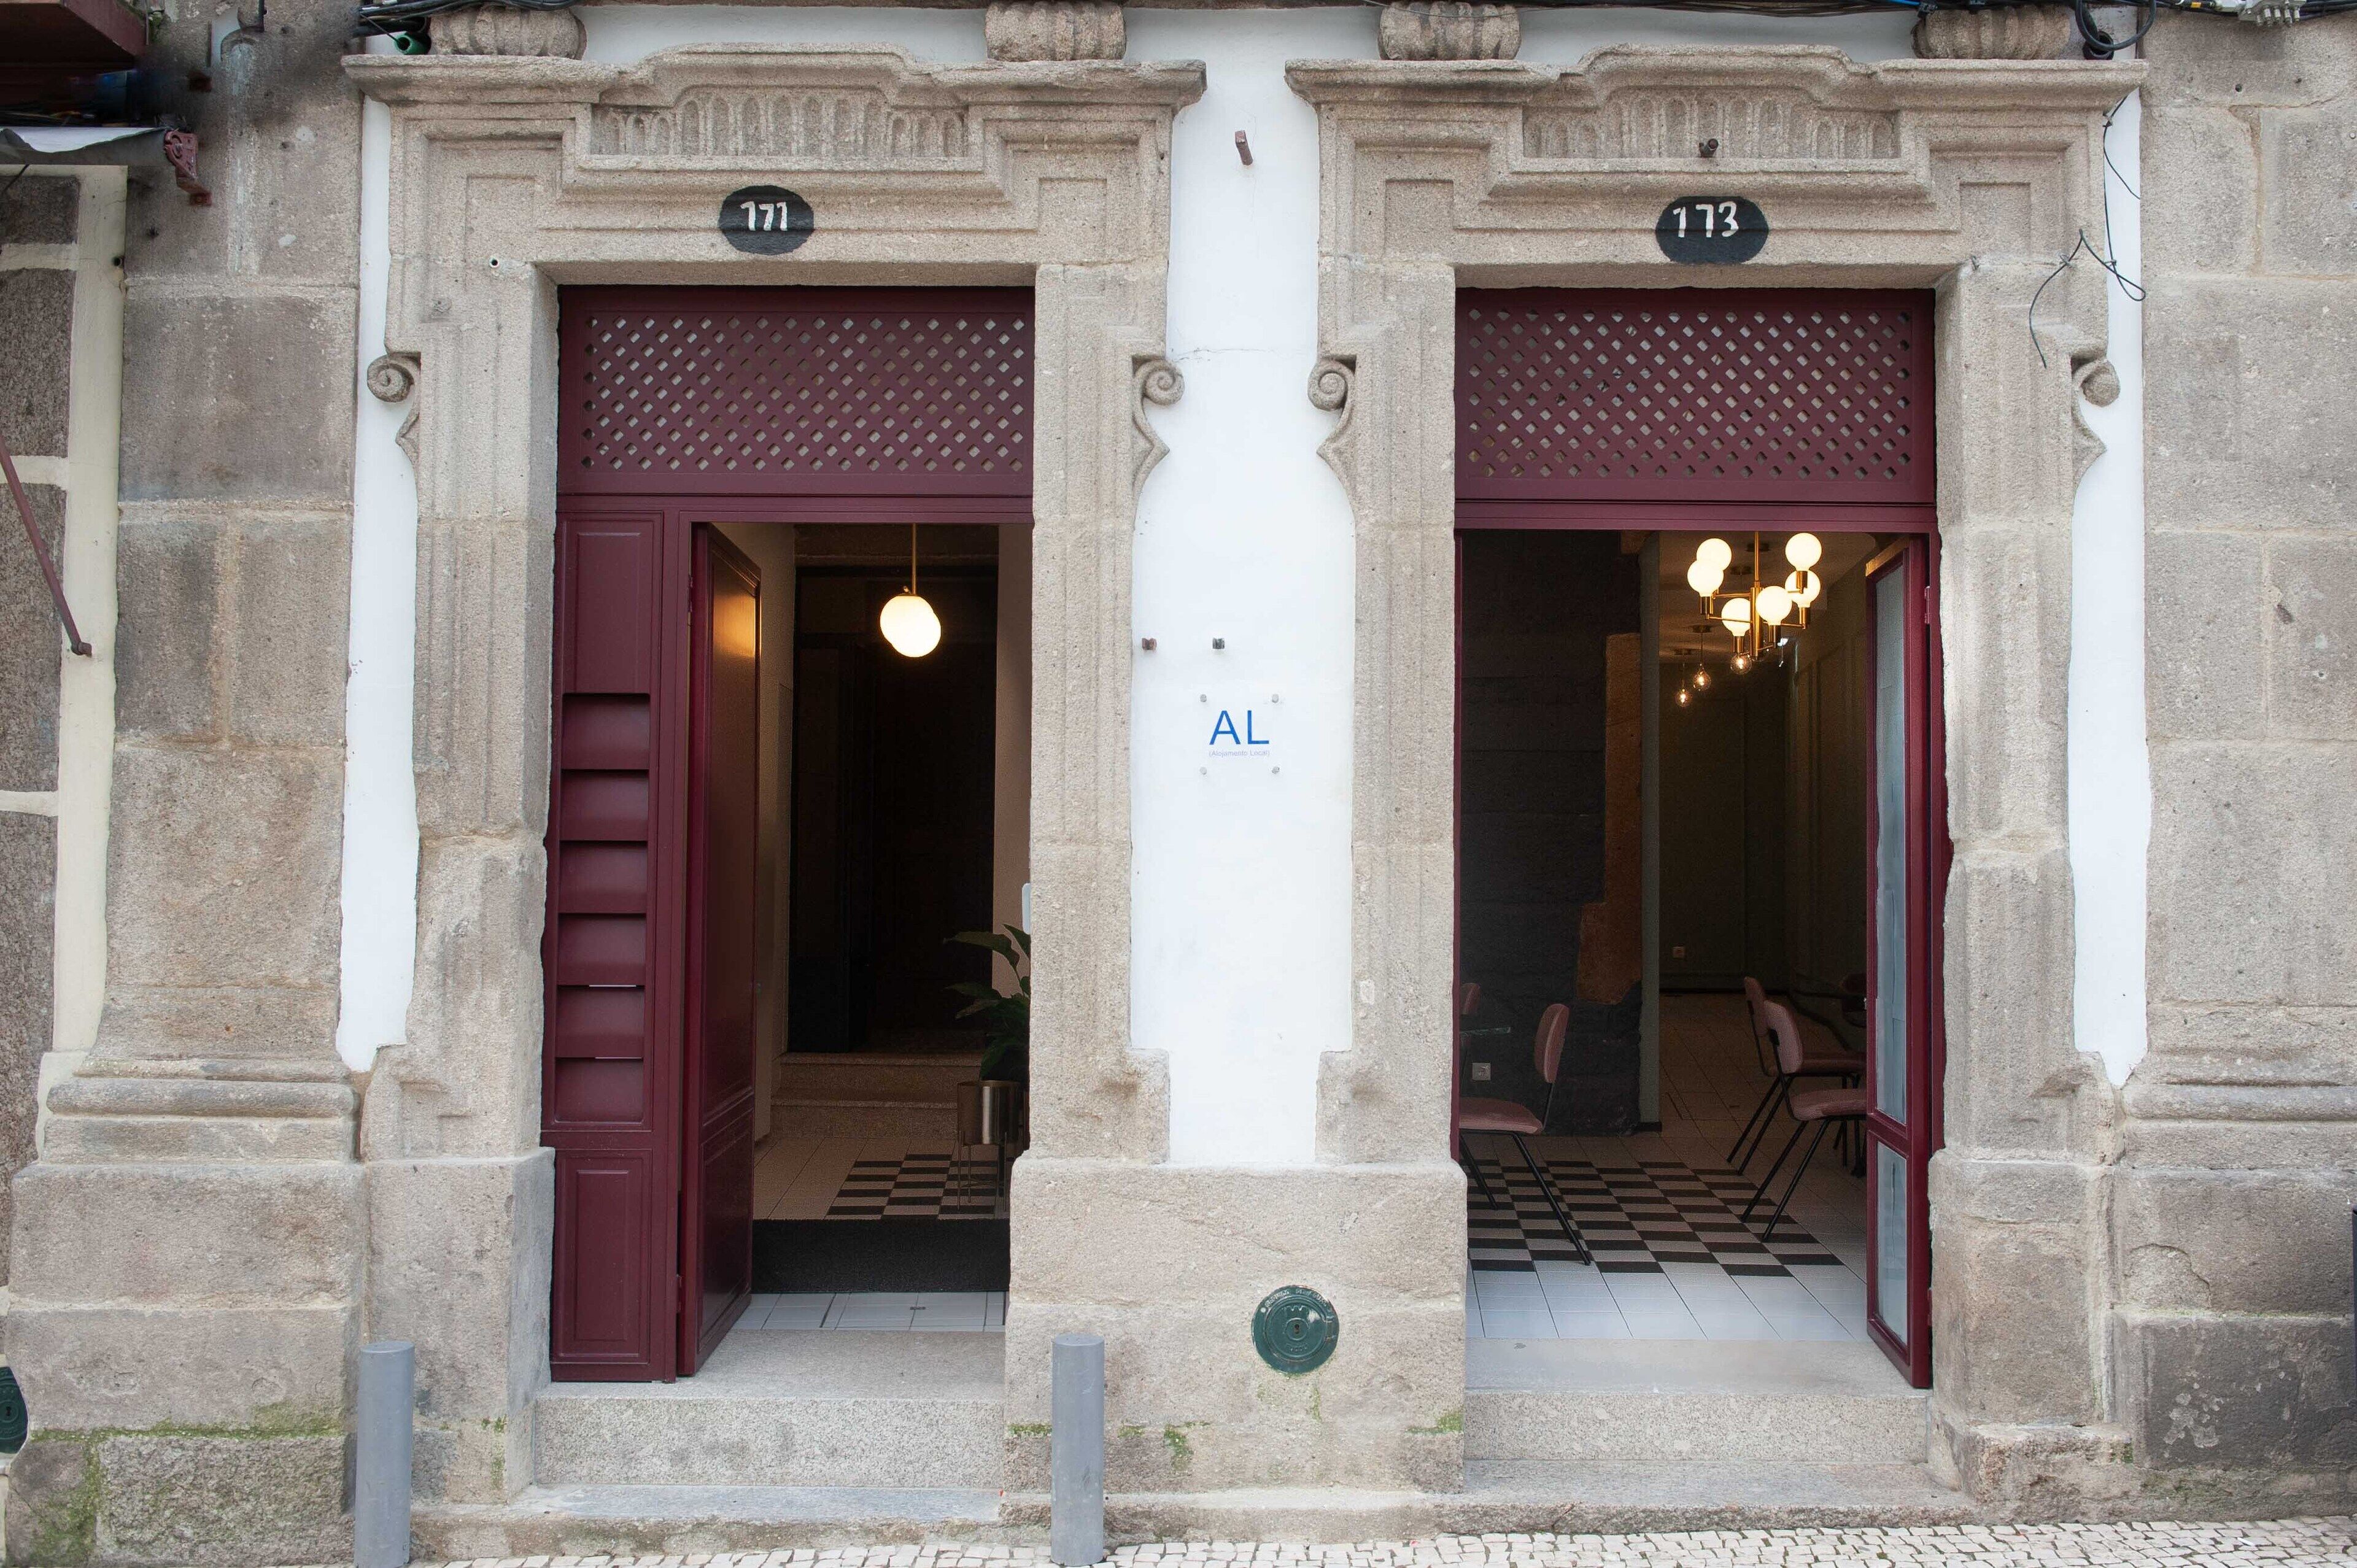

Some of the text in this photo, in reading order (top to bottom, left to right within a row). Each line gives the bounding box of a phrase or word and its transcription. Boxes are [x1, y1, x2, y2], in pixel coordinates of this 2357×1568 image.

[740, 201, 788, 231] 171
[1673, 201, 1740, 238] 173
[1209, 709, 1270, 745] AL
